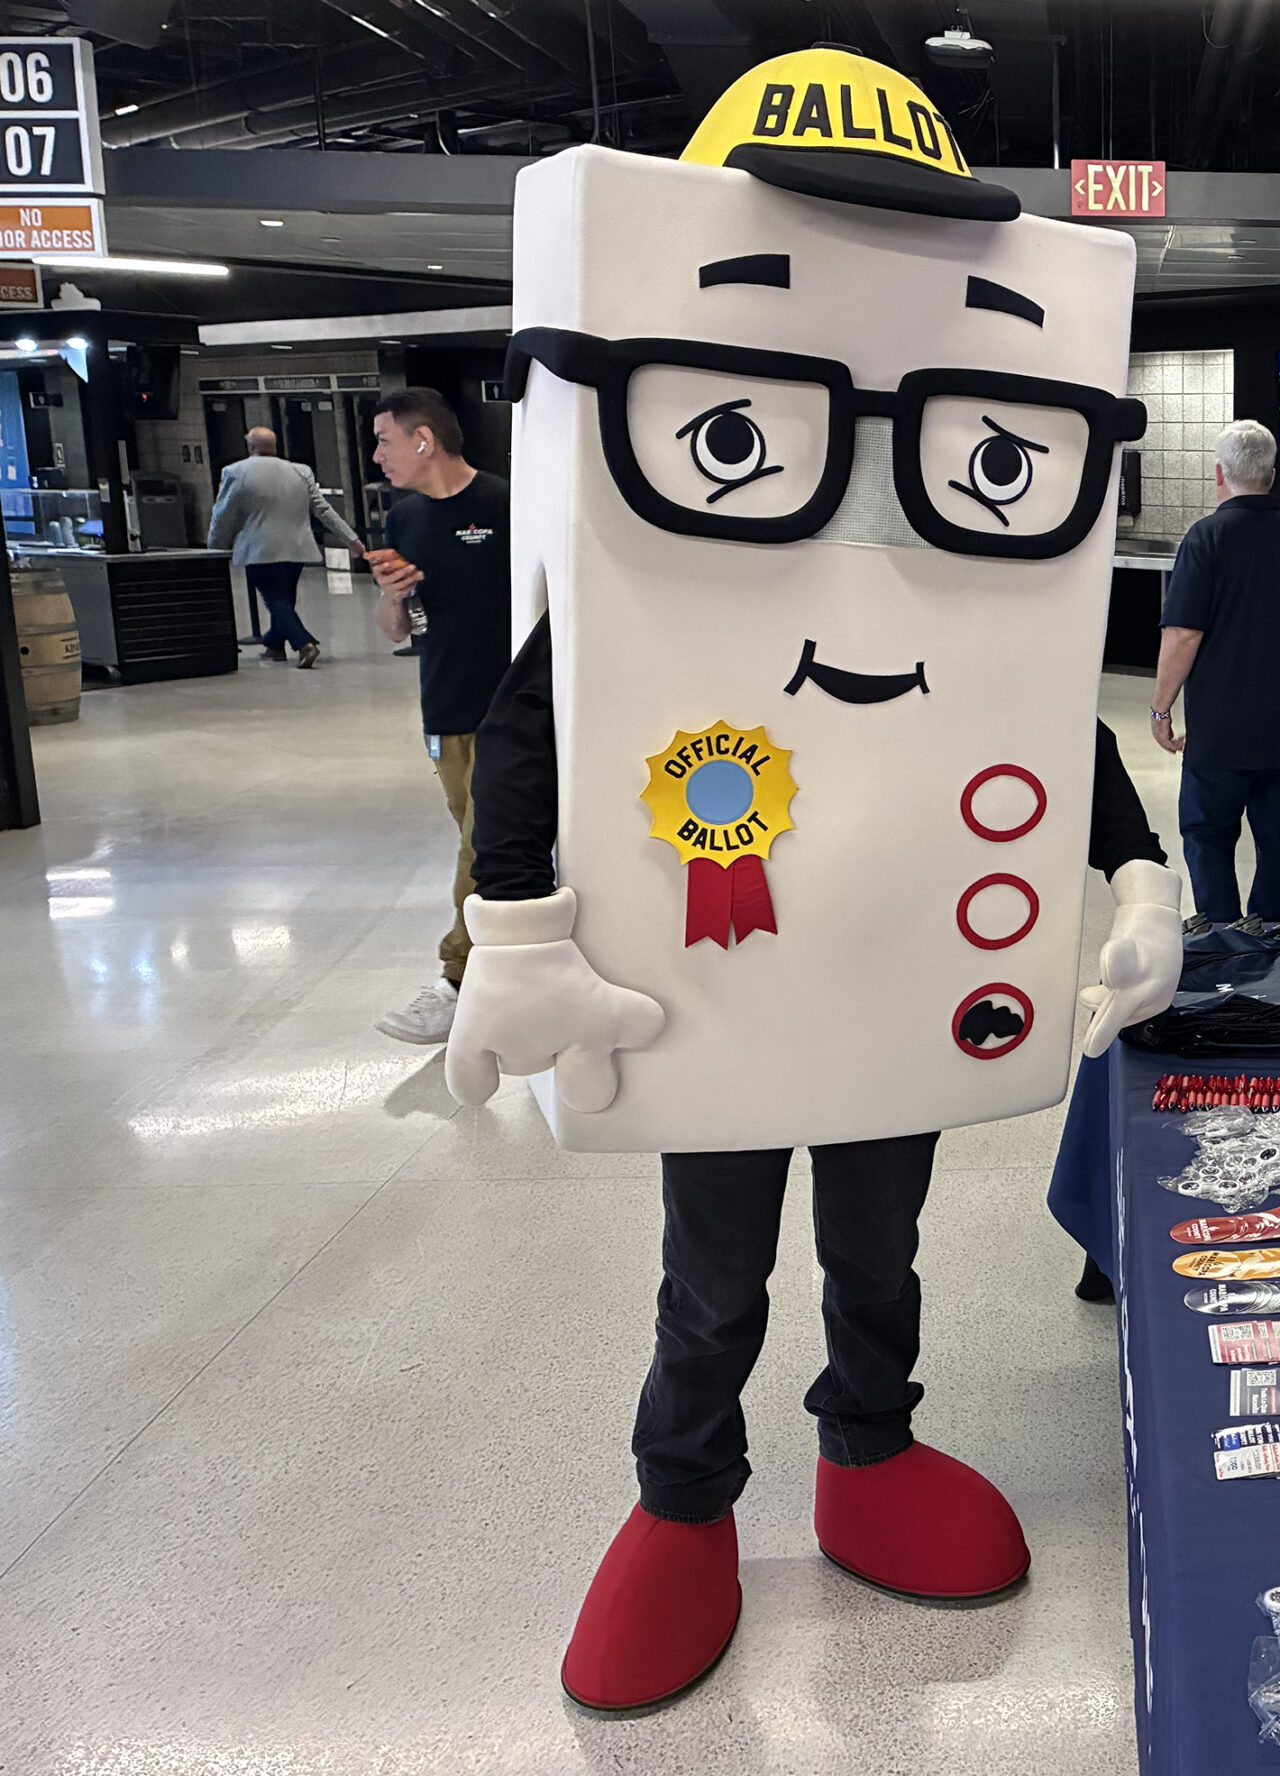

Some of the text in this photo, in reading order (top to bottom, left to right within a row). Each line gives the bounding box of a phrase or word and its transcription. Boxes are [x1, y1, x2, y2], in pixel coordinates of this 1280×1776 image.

[0, 52, 53, 103] 06
[5, 126, 56, 176] 07
[752, 83, 965, 172] BALLOT
[1086, 163, 1154, 212] EXIT
[0, 229, 92, 249] OR ACCESS
[19, 208, 42, 227] NO
[664, 734, 771, 779] OFFICIAL
[676, 810, 769, 851] BALLOT
